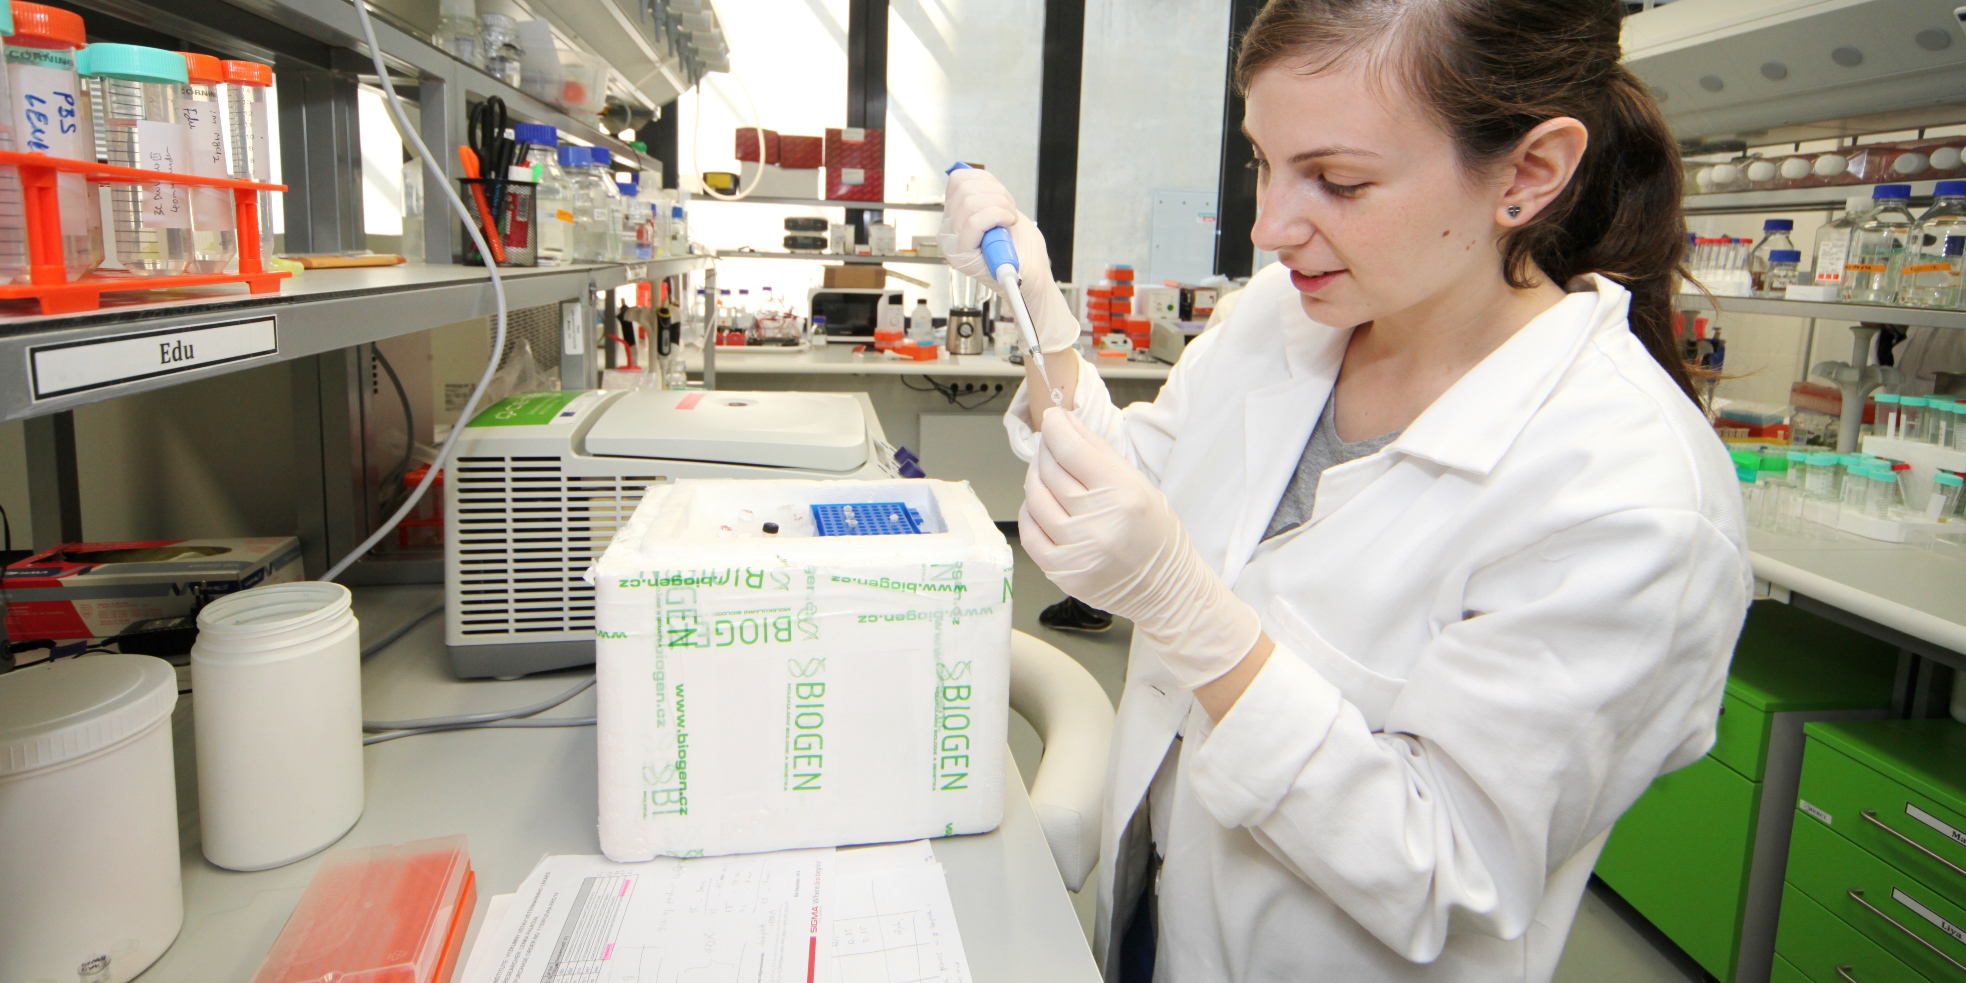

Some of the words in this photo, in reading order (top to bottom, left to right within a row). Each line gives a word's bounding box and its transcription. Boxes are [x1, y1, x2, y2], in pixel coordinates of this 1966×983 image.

[9, 50, 76, 67] CORNING
[53, 91, 76, 134] PBS
[160, 340, 195, 364] Edu
[830, 575, 968, 594] www.biogen.cz
[857, 607, 993, 626] www.biogen.cz
[674, 683, 690, 816] www.biogen.cz
[791, 682, 827, 793] BIOGEN
[939, 684, 973, 792] BIOGEN
[810, 905, 819, 934] SIGMA
